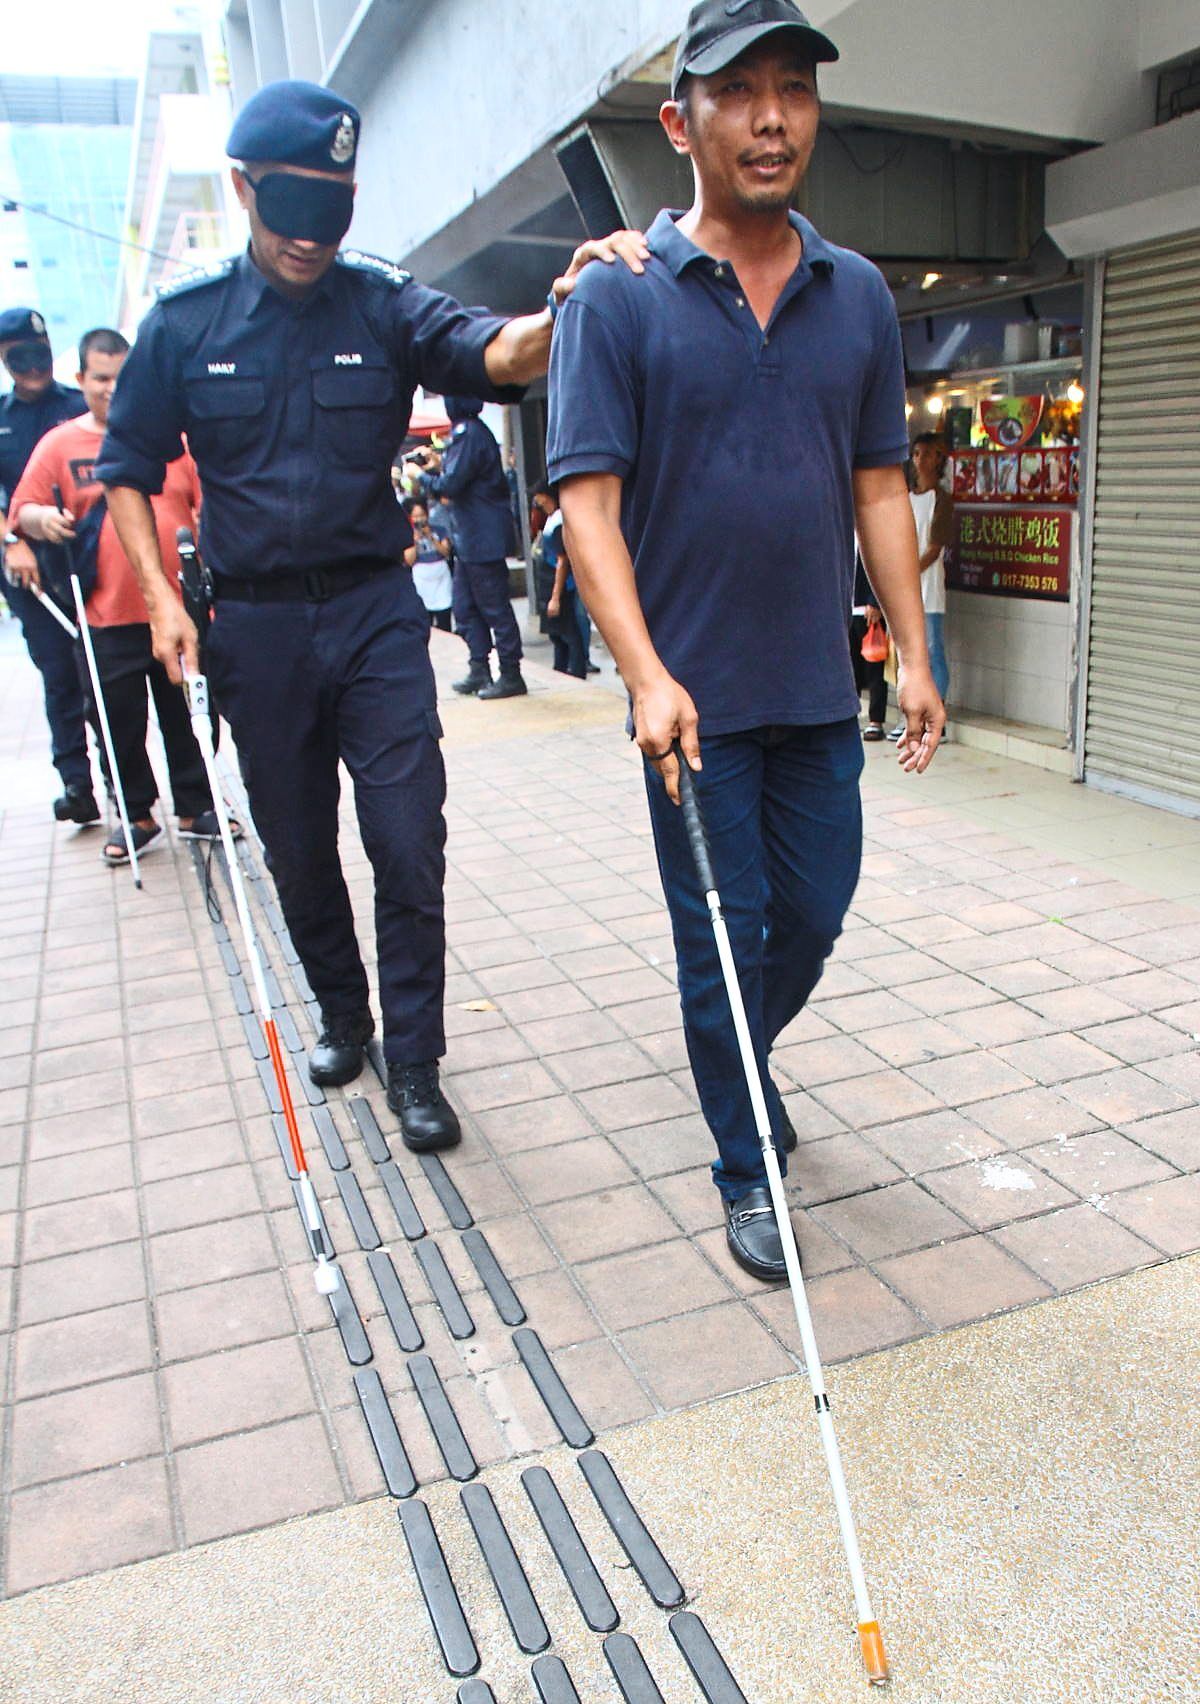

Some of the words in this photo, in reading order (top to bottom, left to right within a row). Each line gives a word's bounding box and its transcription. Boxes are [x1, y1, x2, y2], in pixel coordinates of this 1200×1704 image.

[334, 352, 358, 362] POLIS
[960, 515, 1060, 549] 港式烧腊鸡饭
[1014, 552, 1041, 563] Chicken
[1043, 553, 1059, 565] Rice
[1041, 577, 1058, 591] 576
